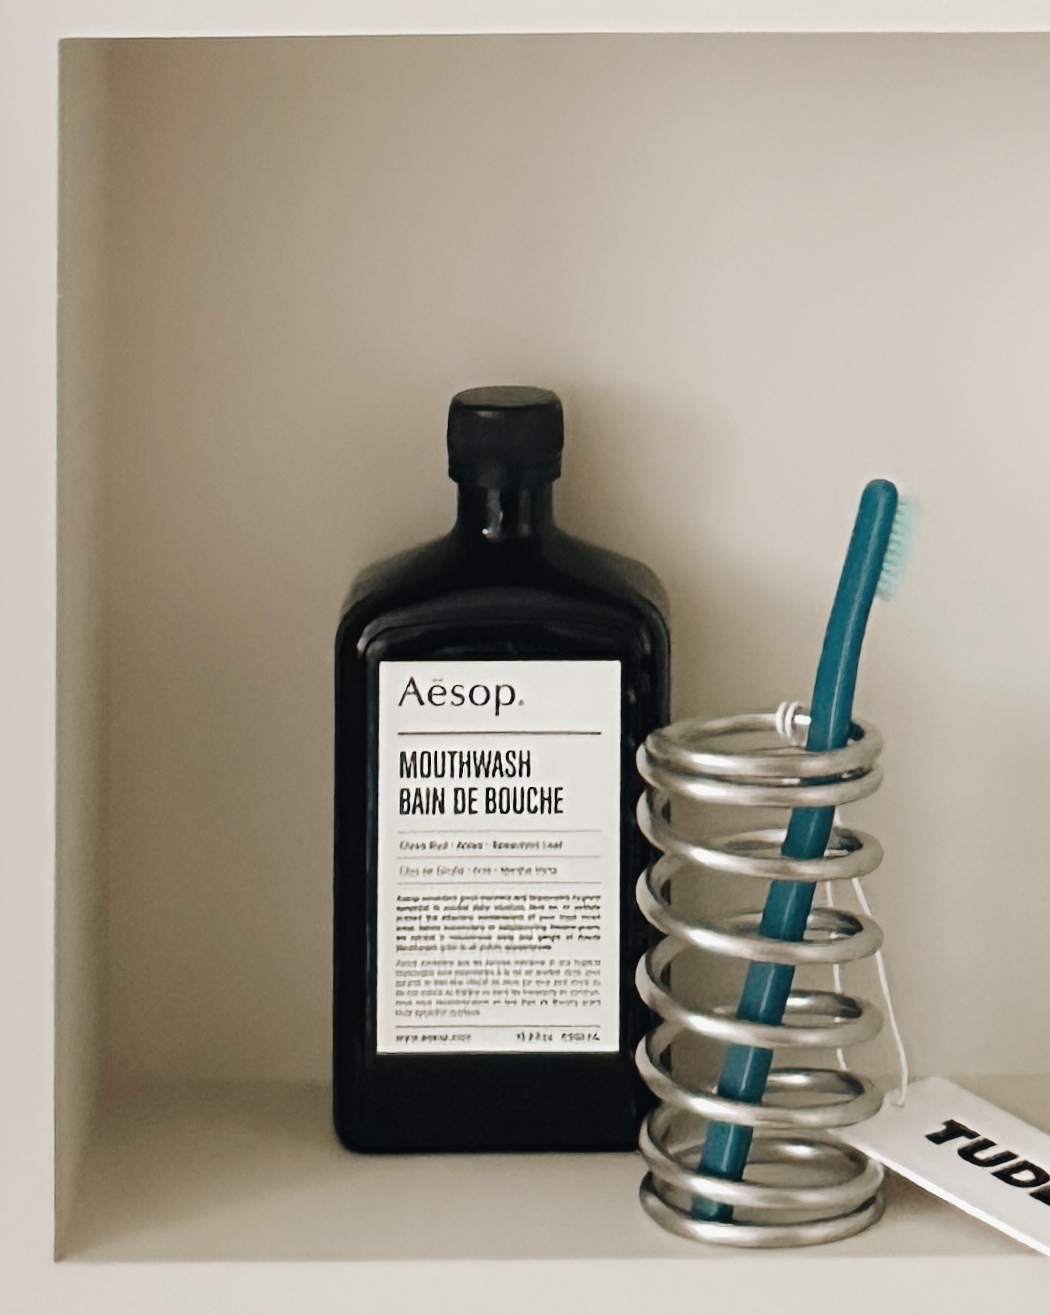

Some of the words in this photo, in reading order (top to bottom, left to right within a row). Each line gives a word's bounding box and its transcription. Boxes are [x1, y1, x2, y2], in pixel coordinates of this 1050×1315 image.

[399, 749, 532, 779] MOUTHWASH
[399, 786, 446, 815] BAIN
[453, 786, 479, 815] DE
[484, 786, 565, 815] BOUCHE
